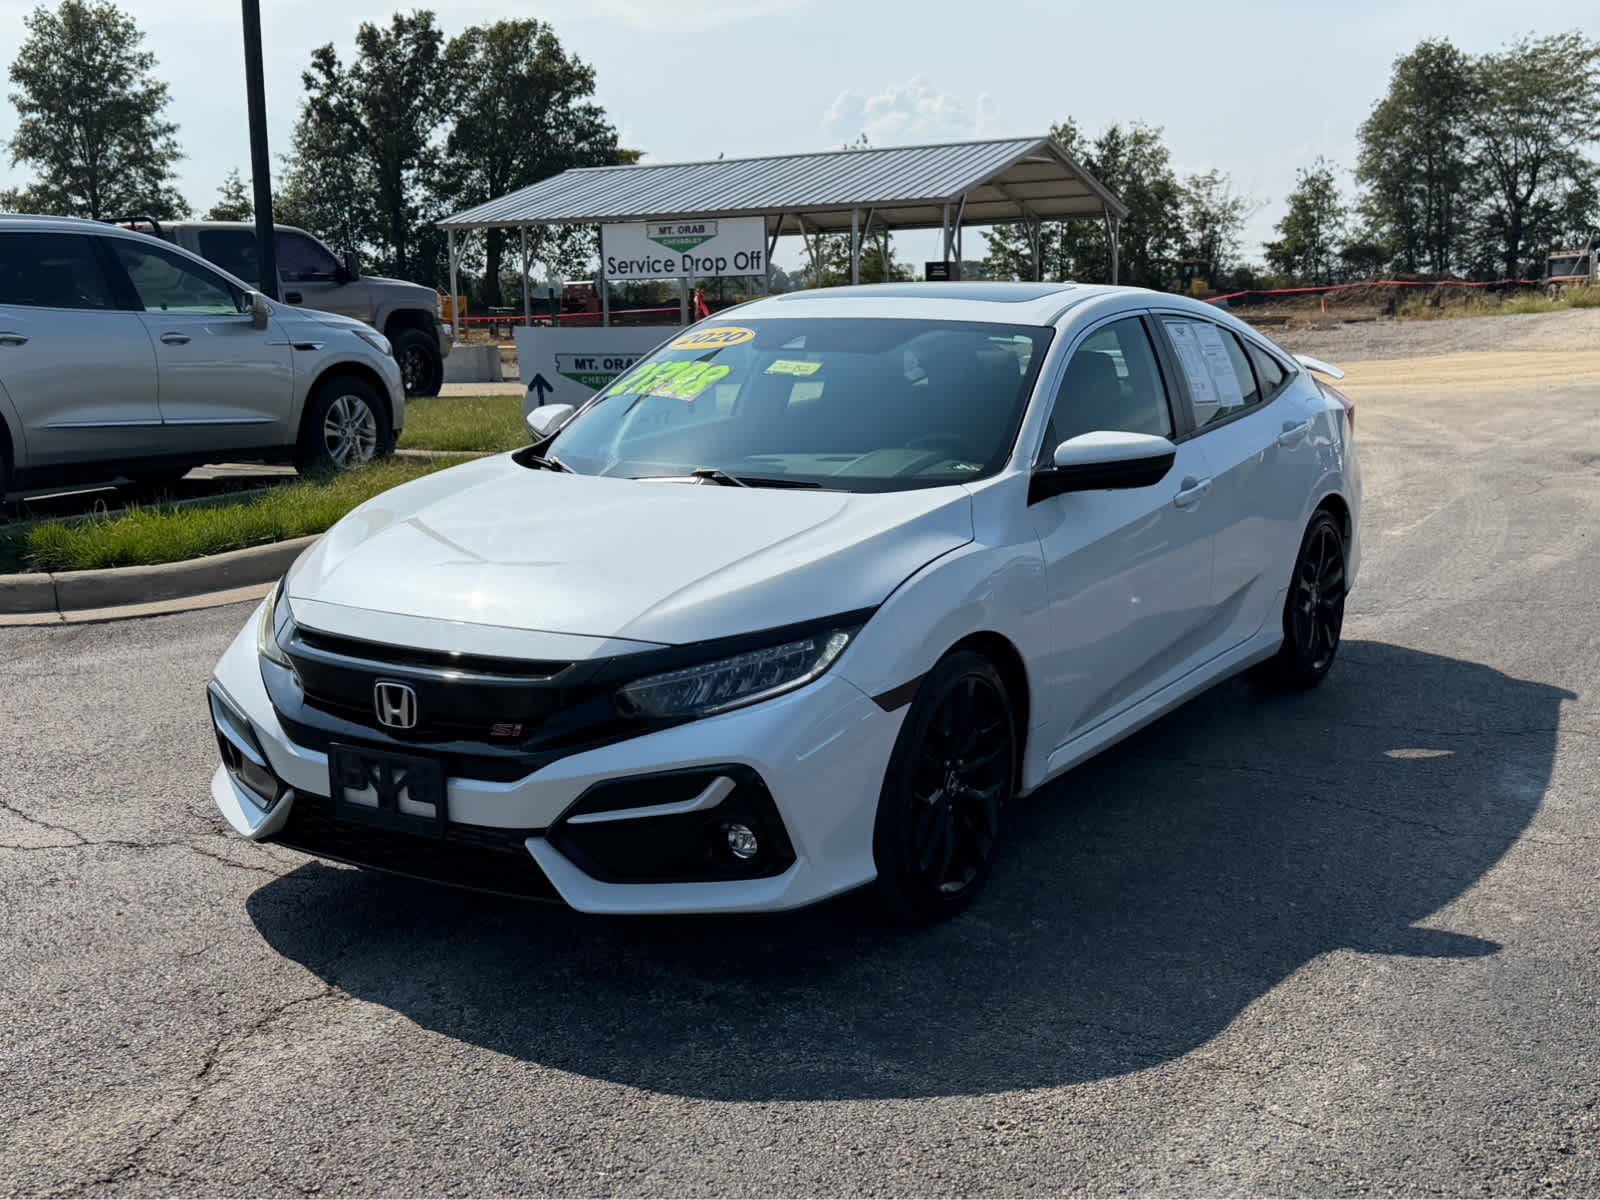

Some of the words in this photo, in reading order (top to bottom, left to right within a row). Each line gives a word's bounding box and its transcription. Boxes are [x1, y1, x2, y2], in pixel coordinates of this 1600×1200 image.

[658, 226, 674, 235] MT.
[678, 224, 705, 234] ORAB
[608, 256, 675, 275] Service
[682, 254, 727, 275] Drop
[734, 251, 762, 270] Off
[574, 358, 598, 370] MT.
[603, 357, 640, 370] ORA
